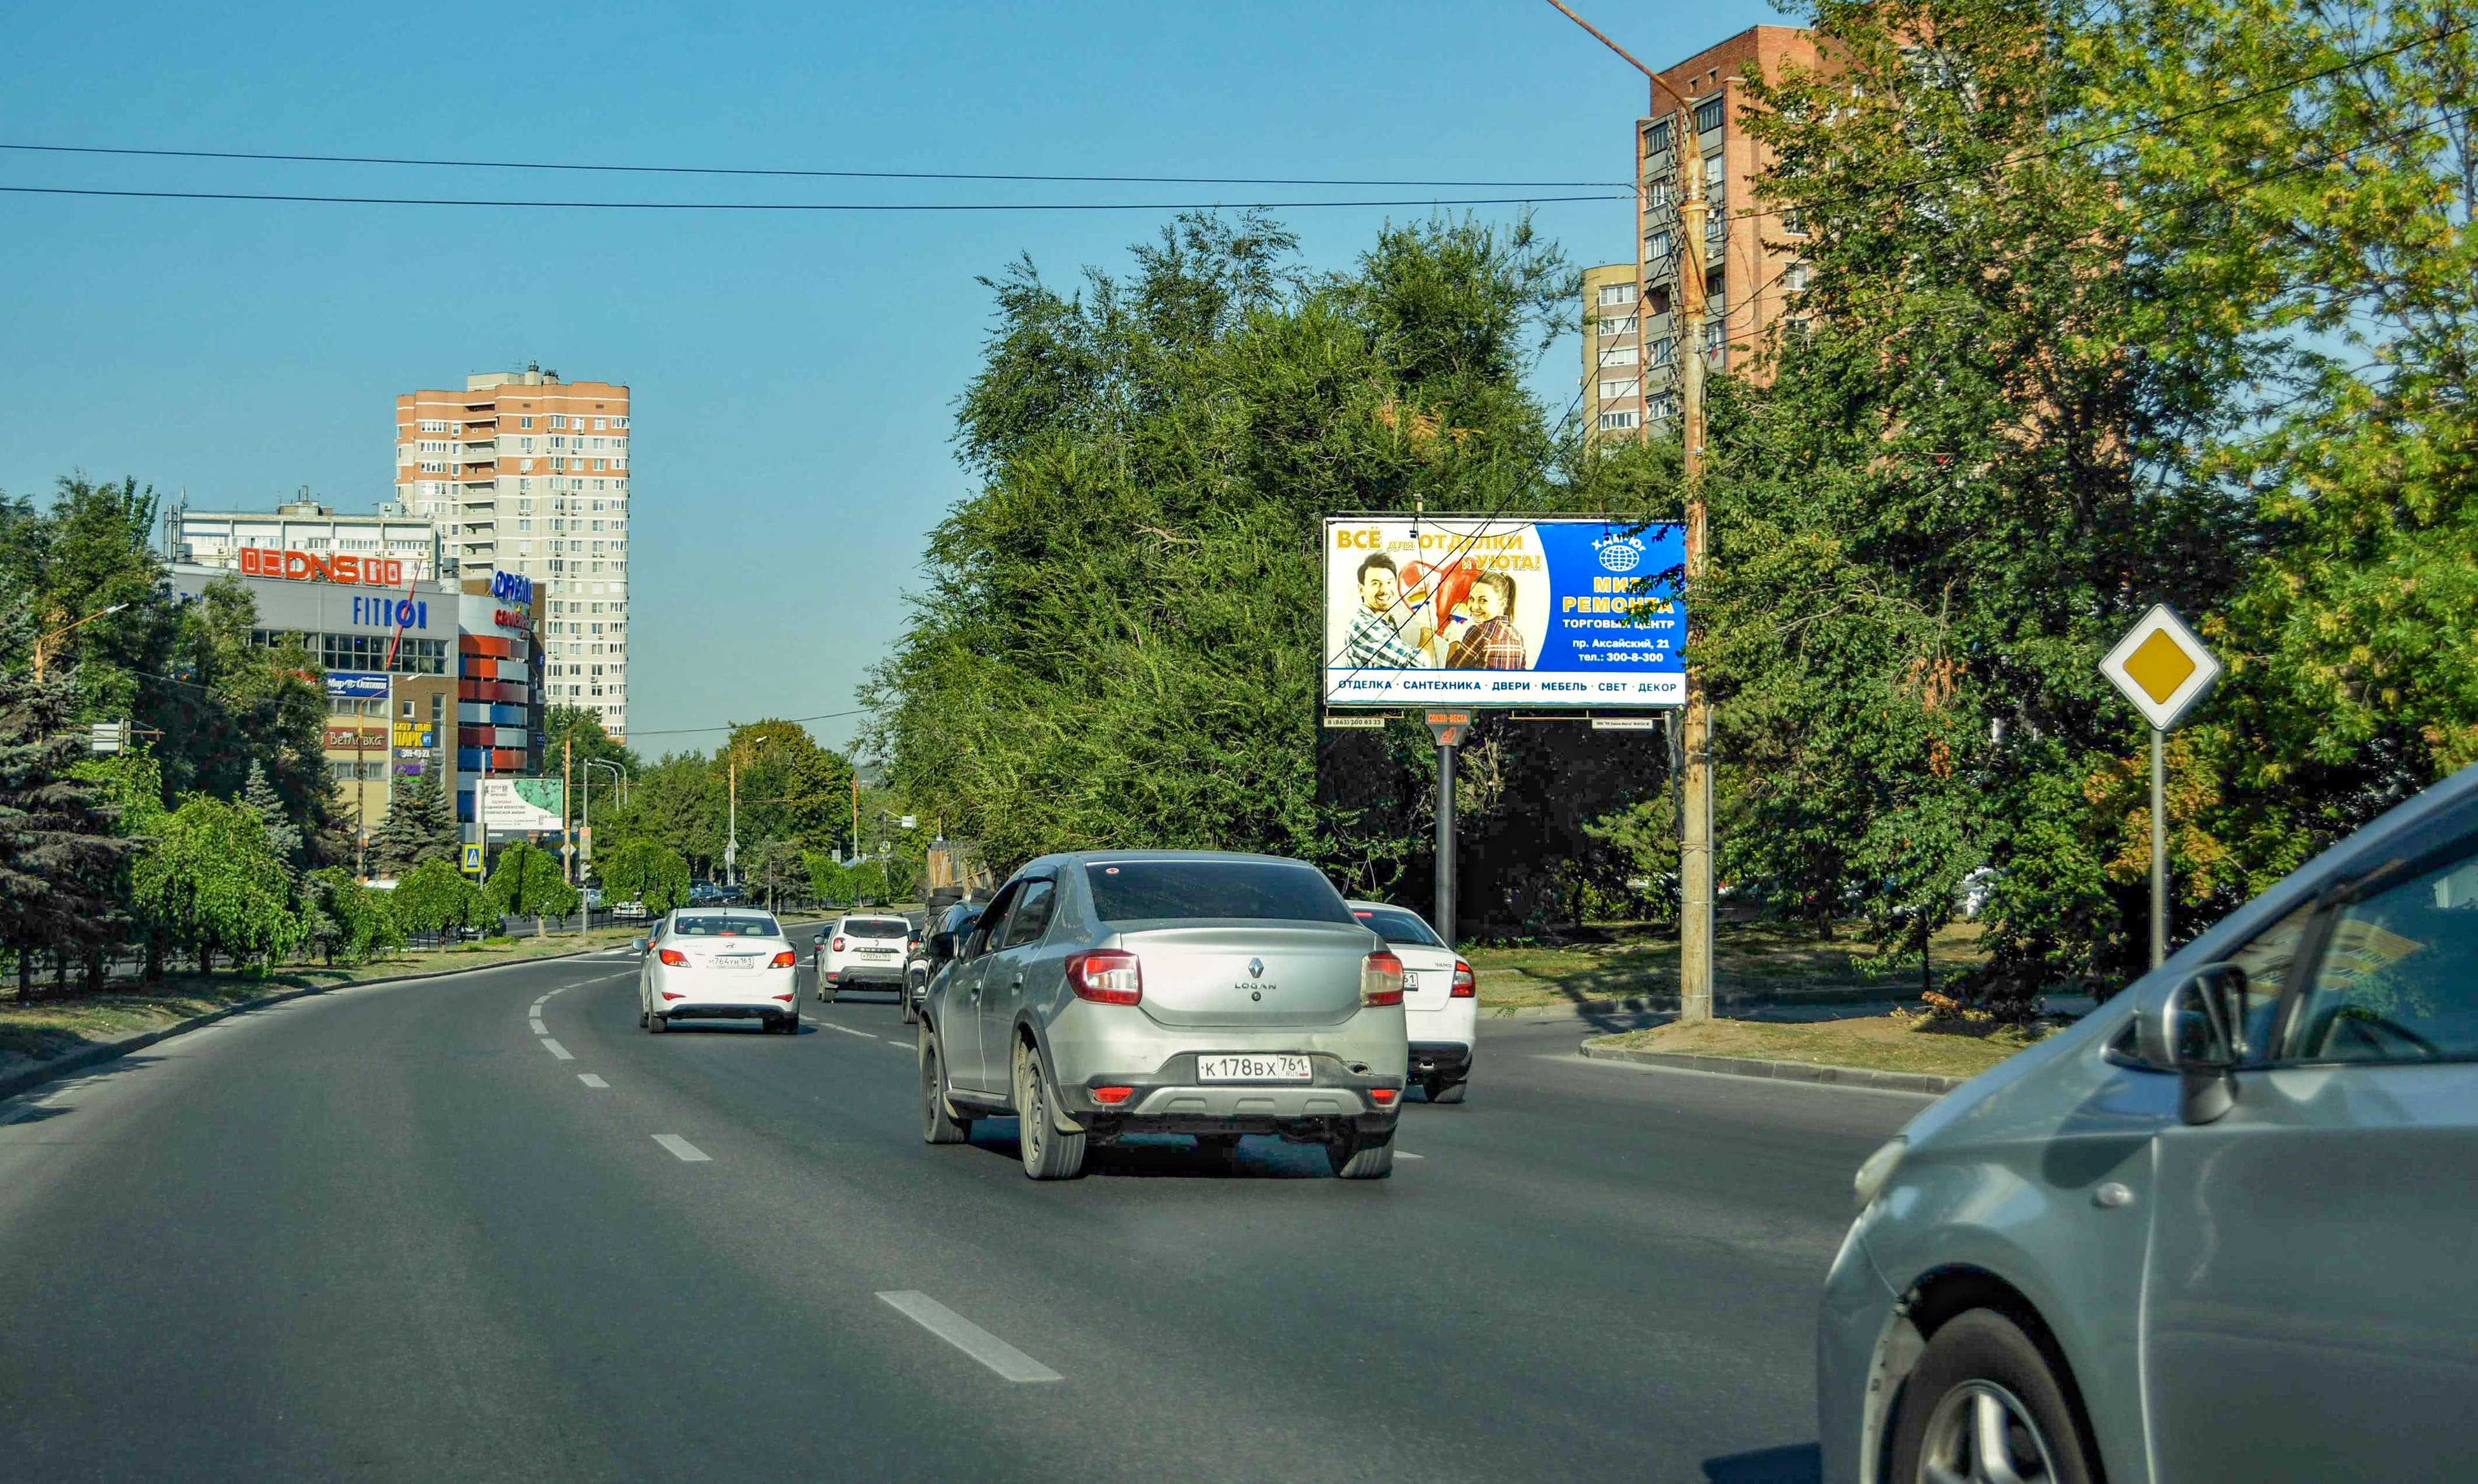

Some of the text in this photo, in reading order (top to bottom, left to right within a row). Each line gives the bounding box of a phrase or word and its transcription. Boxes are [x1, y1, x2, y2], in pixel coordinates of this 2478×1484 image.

[1336, 526, 1523, 552] ВСЁ для ОТДЕЛКИ
[285, 550, 361, 585] DNS
[1476, 554, 1542, 571] УЮТА!
[353, 596, 427, 629] FITRON
[1562, 619, 1631, 629] ТОРГОВЫ
[1572, 638, 1670, 650] пр. Аксайский, 21
[1578, 653, 1664, 662] тел.: 300-8-300
[1338, 680, 1677, 692] ОТДЕЛКА САНТЕХНИКА ДВЕРИ МЕБЕЛЬ СВЕТ ДЕКОР
[394, 731, 423, 747] ПАРК
[1205, 1058, 1305, 1077] К178ВХ 761
